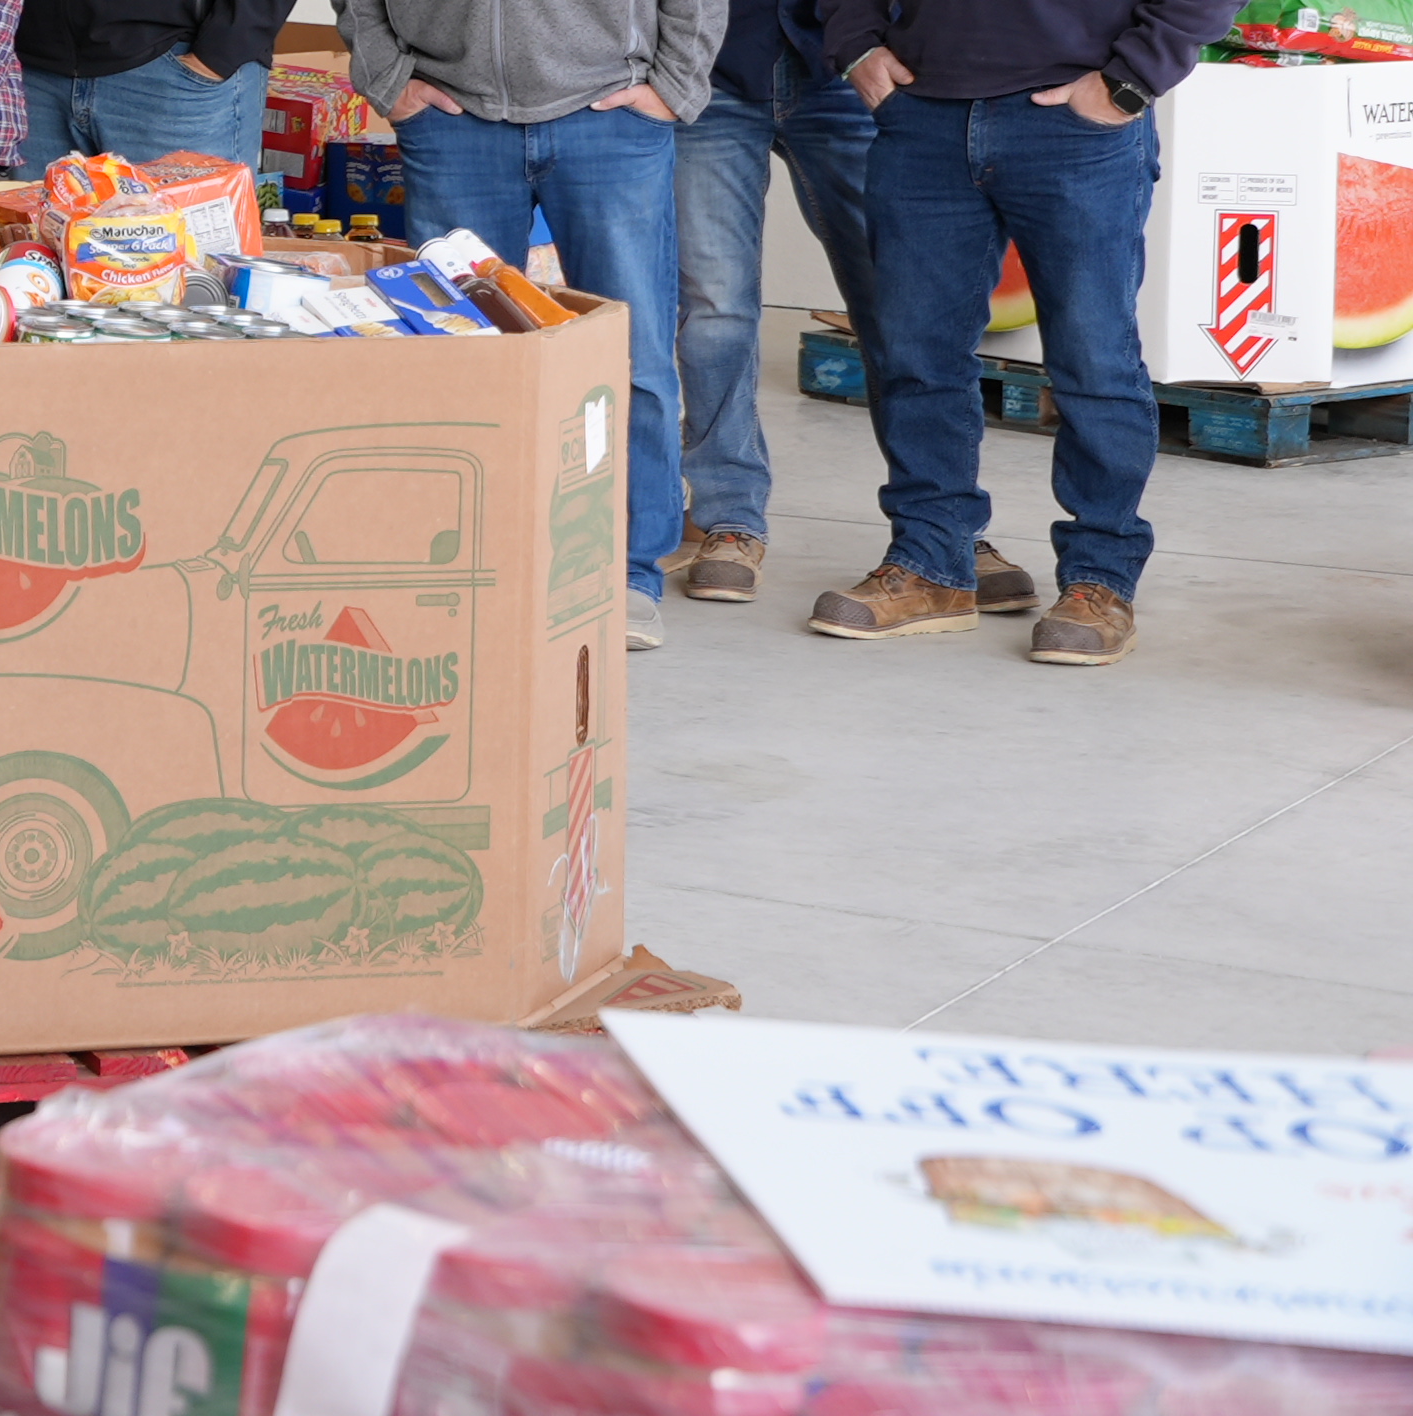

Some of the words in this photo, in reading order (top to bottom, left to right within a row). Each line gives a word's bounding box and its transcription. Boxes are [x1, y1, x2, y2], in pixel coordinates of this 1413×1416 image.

[101, 225, 164, 238] Maruchan
[131, 241, 140, 251] 6
[101, 269, 150, 285] Chicken
[152, 263, 174, 278] Flavor
[258, 600, 324, 640] Fresh
[260, 639, 459, 707] WATERMELONS
